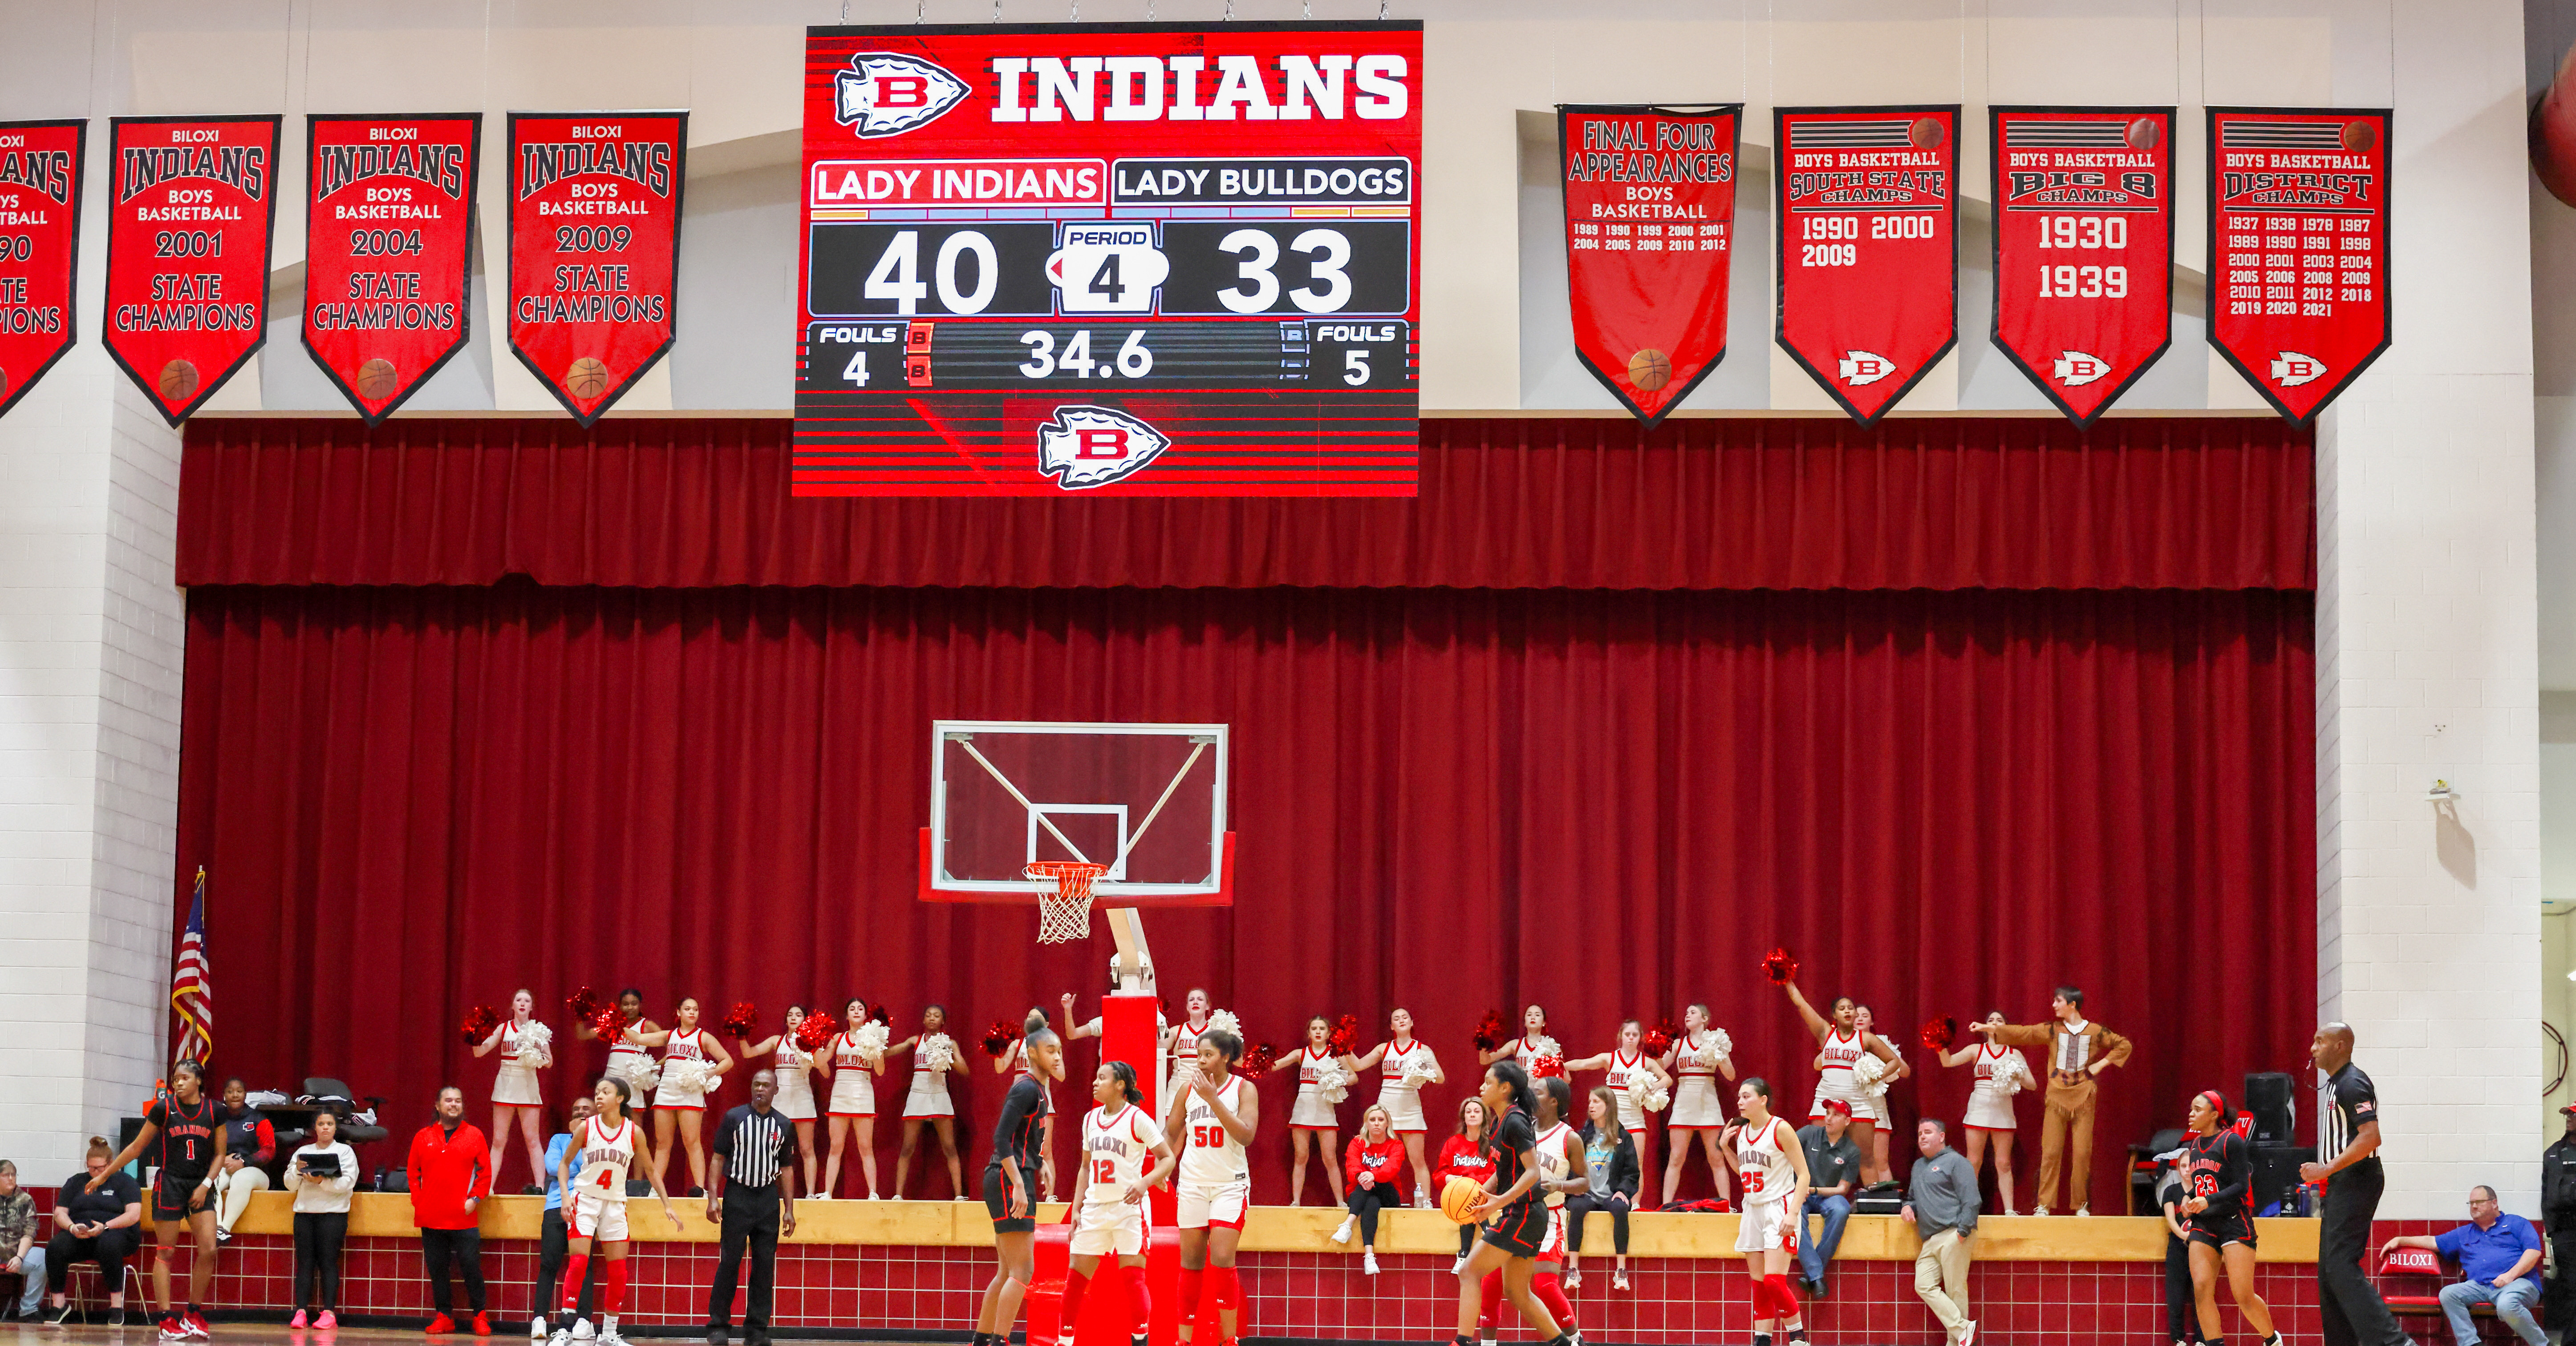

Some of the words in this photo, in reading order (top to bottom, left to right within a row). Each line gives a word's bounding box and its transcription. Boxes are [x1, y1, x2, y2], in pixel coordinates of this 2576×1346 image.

[873, 77, 928, 108] B
[991, 55, 1408, 122] INDIANS
[0, 135, 24, 147] OXI
[172, 130, 219, 142] BILOXI
[370, 128, 417, 140] BILOXI
[572, 125, 621, 138] BILOXI
[1584, 121, 1648, 150] FINAL
[1656, 122, 1716, 151] FOUR
[1568, 152, 1732, 183] APPEARANCES
[1794, 154, 1833, 167] BOYS
[1839, 152, 1939, 166] BASKETBALL
[2010, 153, 2048, 166] BOYS
[2055, 154, 2155, 167] BASKETBALL
[2226, 154, 2264, 167] BOYS
[2271, 154, 2371, 169] BASKETBALL
[121, 146, 264, 204] INDIANS
[318, 144, 463, 203] INDIANS
[520, 142, 670, 202] INDIANS
[1118, 169, 1211, 196] LADY
[1220, 168, 1404, 196] BULLDOGS
[572, 183, 618, 198] BOYS
[818, 170, 922, 200] LADY
[933, 168, 1097, 199] INDIANS
[1627, 186, 1673, 201] BOYS
[1790, 172, 1863, 201] SOUTH
[1869, 170, 1945, 199] STATE
[2009, 171, 2105, 201] BIG
[2121, 172, 2156, 199] 8
[2224, 172, 2372, 201] DISTRICT
[0, 195, 19, 208] YS
[169, 189, 213, 203] BOYS
[366, 188, 412, 202] BOYS
[1821, 188, 1912, 203] CHAMPS
[2037, 188, 2127, 203] CHAMPS
[2253, 190, 2343, 204] CHAMPS
[138, 206, 242, 221] BASKETBALL
[336, 203, 441, 219] BASKETBALL
[540, 200, 649, 215] BASKETBALL
[1592, 204, 1707, 219] BASKETBALL
[1574, 223, 1598, 235] 1989
[1605, 225, 1630, 236] 1990
[1637, 225, 1662, 236] 1999
[1668, 225, 1693, 236] 2000
[1700, 224, 1724, 236] 2001
[1803, 217, 1858, 240] 1990
[1872, 215, 1934, 239] 2000
[2039, 216, 2127, 249] 1930
[2229, 217, 2259, 230] 1937
[2266, 218, 2296, 231] 1938
[2303, 218, 2333, 231] 1978
[2340, 219, 2370, 232] 1987
[0, 235, 32, 261] 90
[155, 229, 222, 258] 2001
[350, 229, 423, 256] 2004
[556, 225, 632, 253] 2009
[1070, 231, 1147, 246] PERIOD
[1574, 238, 1599, 250] 2004
[1605, 239, 1631, 250] 2005
[1637, 239, 1662, 251] 2009
[1669, 240, 1694, 251] 2010
[1700, 239, 1726, 251] 2012
[2229, 235, 2259, 248] 1989
[2266, 236, 2296, 249] 1990
[2303, 236, 2330, 250] 1991
[2340, 237, 2371, 250] 1998
[1802, 244, 1856, 267] 2009
[2229, 253, 2260, 267] 2000
[2266, 254, 2294, 267] 2001
[2303, 255, 2334, 268] 2003
[2340, 255, 2372, 269] 2004
[555, 264, 629, 292] STATE
[864, 230, 998, 315] 40
[1088, 254, 1125, 303] 4
[1217, 228, 1352, 314] 33
[2039, 265, 2127, 298] 1939
[2230, 270, 2259, 283] 2005
[2266, 271, 2295, 284] 2006
[2304, 271, 2333, 284] 2008
[2342, 272, 2370, 284] 2009
[151, 274, 222, 300] STATE
[349, 272, 420, 300] STATE
[2230, 285, 2260, 299] 2010
[2266, 286, 2294, 299] 2011
[2303, 287, 2333, 300] 2012
[2341, 288, 2372, 302] 2018
[116, 303, 255, 332] CHAMPIONS
[314, 302, 454, 330] CHAMPIONS
[518, 295, 665, 323] CHAMPIONS
[2231, 301, 2261, 315] 2019
[2266, 301, 2296, 315] 2020
[2303, 303, 2332, 316] 2021
[819, 327, 897, 344] FOULS
[1317, 326, 1396, 342] FOULS
[1019, 330, 1153, 379] 34.6
[843, 351, 870, 387] 4
[1343, 349, 1371, 386] 5
[1856, 361, 1880, 375] B
[2071, 361, 2095, 375] B
[2288, 362, 2312, 376] B
[1075, 429, 1129, 459] B
[1977, 1064, 1993, 1077] BIL
[158, 1091, 165, 1099] G
[1194, 1126, 1224, 1148] 50
[186, 1139, 195, 1160] 1
[596, 1169, 613, 1190] 4
[1093, 1159, 1116, 1184] 12
[1741, 1171, 1764, 1193] 25
[2195, 1174, 2219, 1197] 23
[1464, 1190, 1483, 1213] Wilso
[2389, 1253, 2433, 1266] BILOXI
